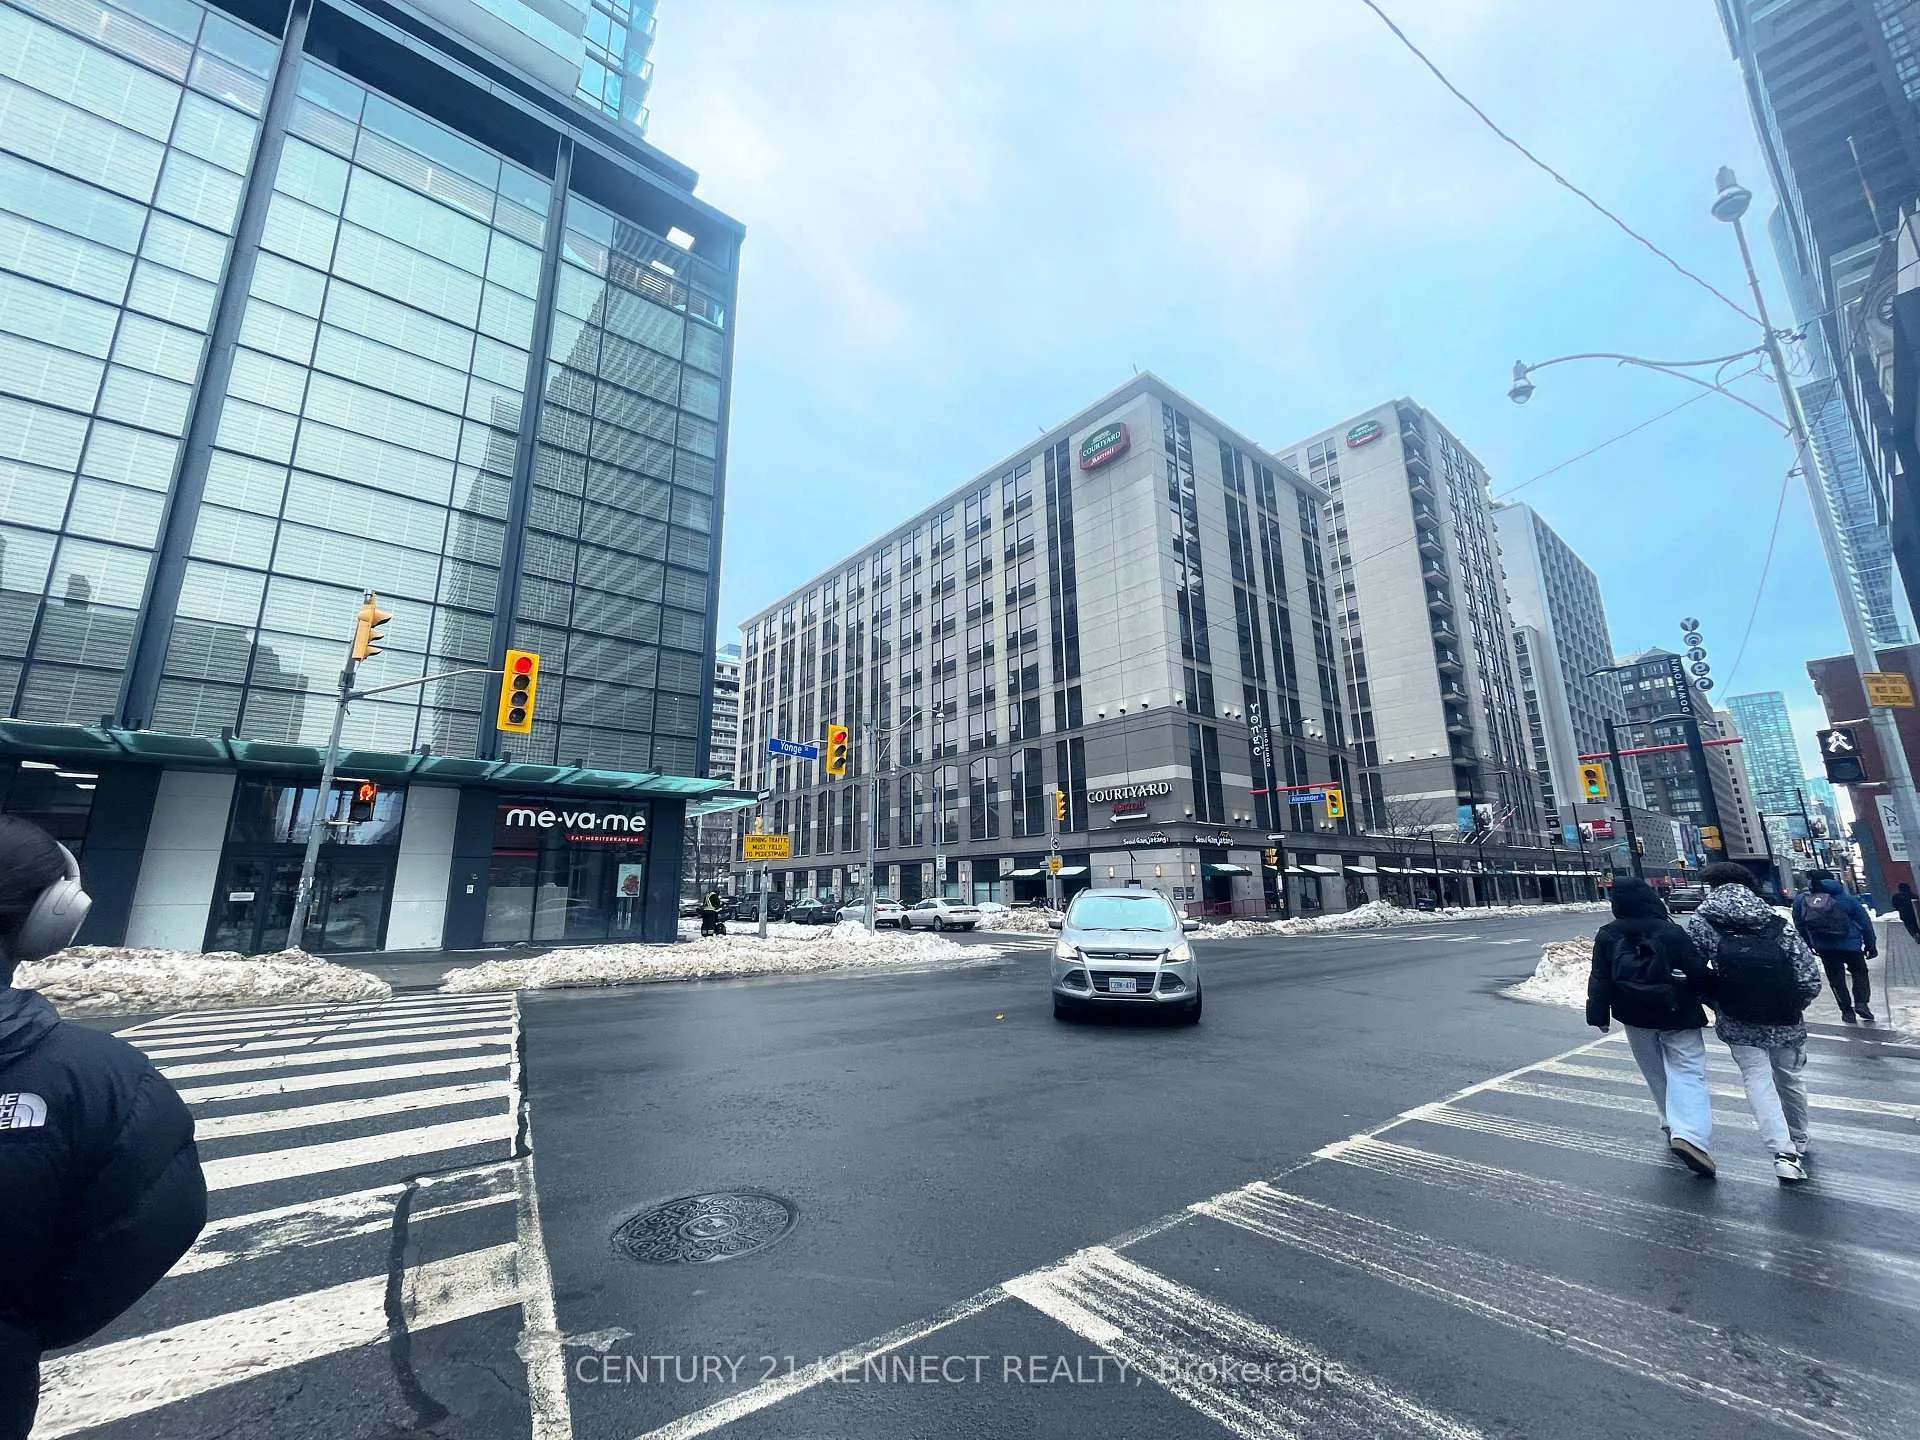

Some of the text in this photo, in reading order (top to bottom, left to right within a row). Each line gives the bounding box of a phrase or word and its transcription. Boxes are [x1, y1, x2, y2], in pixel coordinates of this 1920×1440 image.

[1082, 431, 1121, 457] COURTYARD
[1670, 658, 1690, 713] DOWNTOWN
[780, 740, 803, 755] Yonge
[1087, 782, 1170, 804] COURTYARD
[1291, 794, 1320, 802] Alexander
